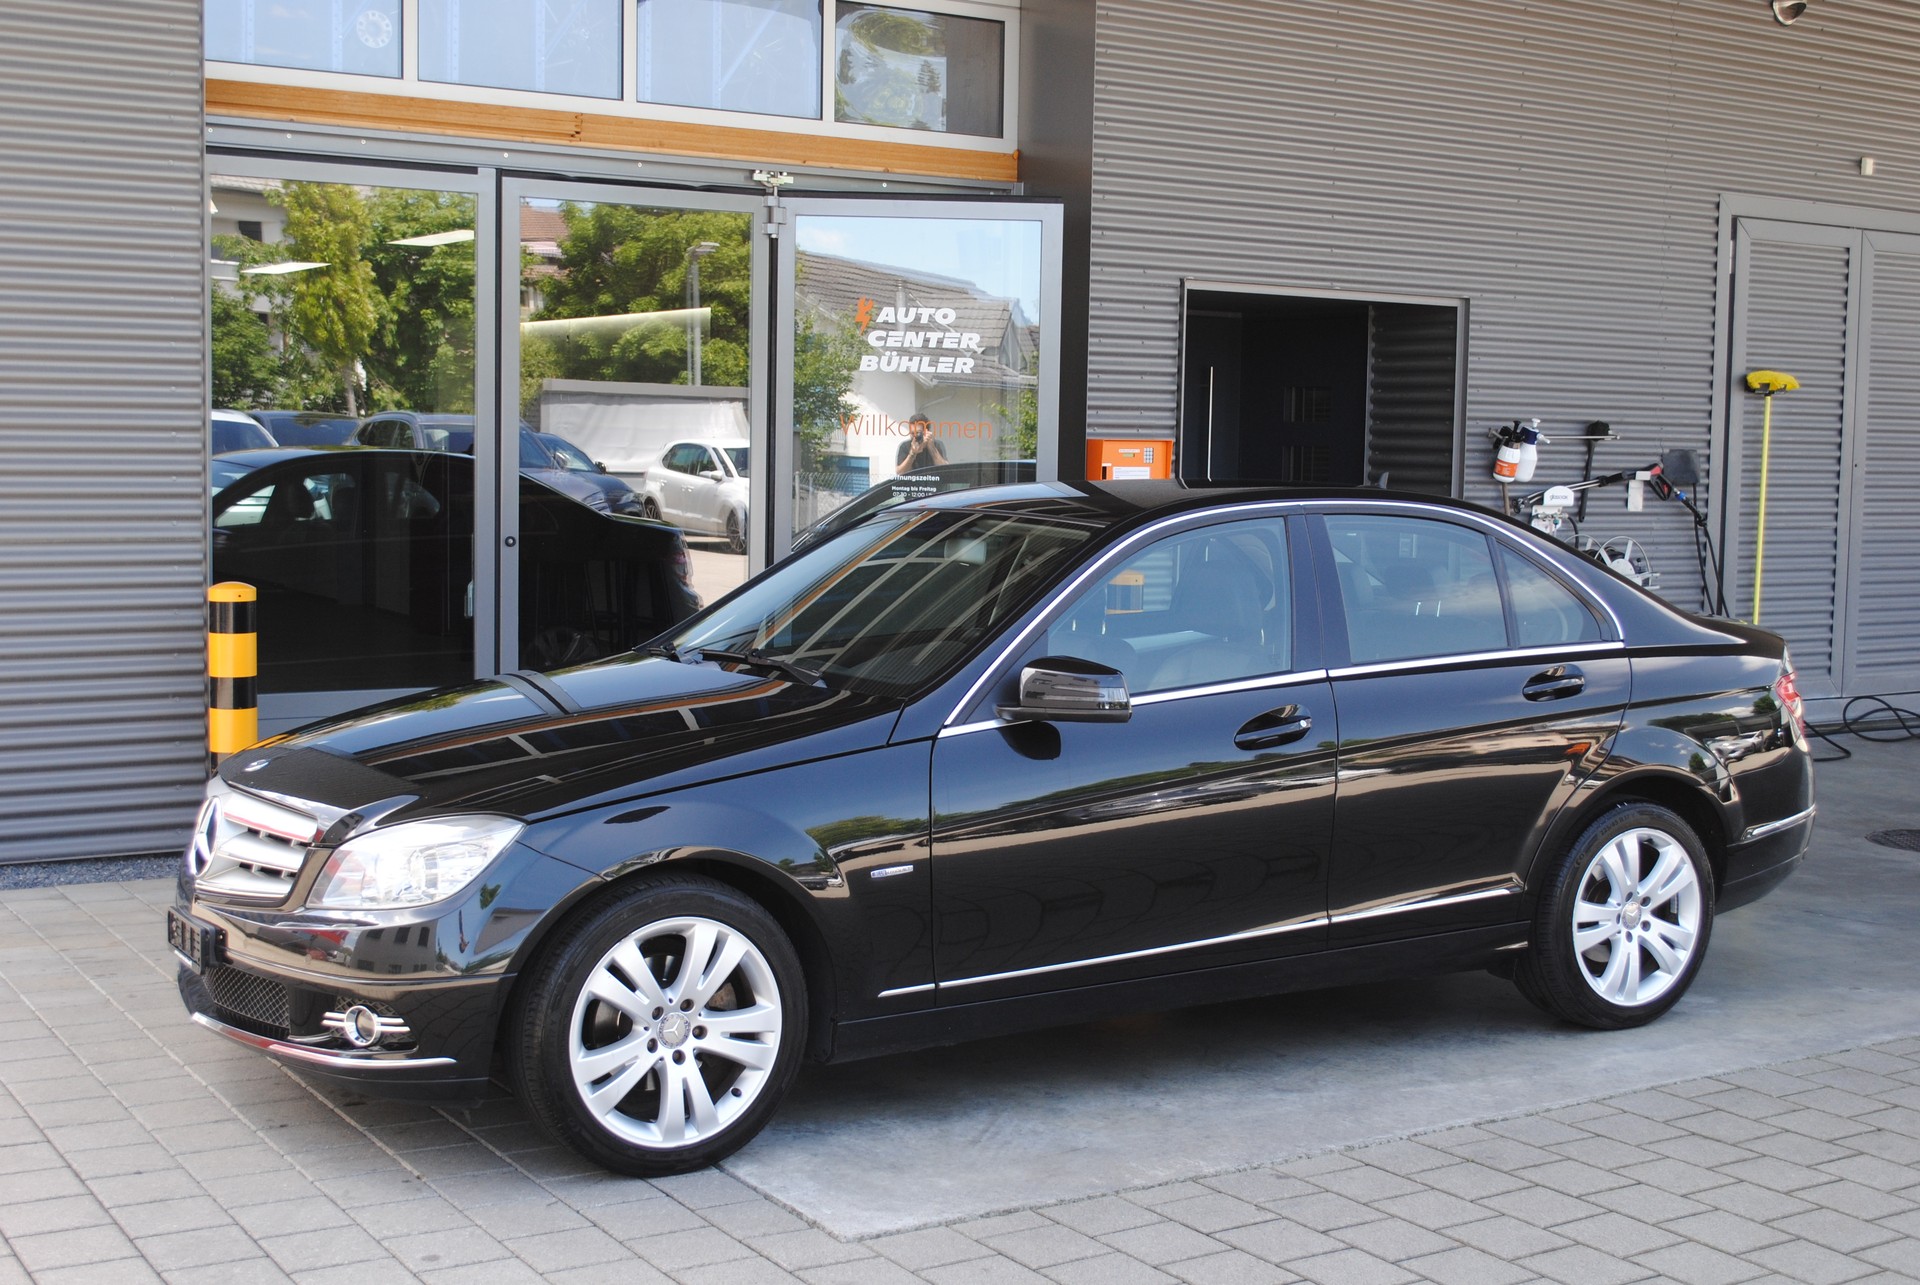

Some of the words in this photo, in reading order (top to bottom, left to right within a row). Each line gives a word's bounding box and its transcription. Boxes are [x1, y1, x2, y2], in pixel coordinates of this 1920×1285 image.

[876, 307, 956, 324] AUTO
[867, 330, 981, 348] CENTER
[859, 351, 975, 374] BÜHLER
[839, 413, 993, 440] Willkommen
